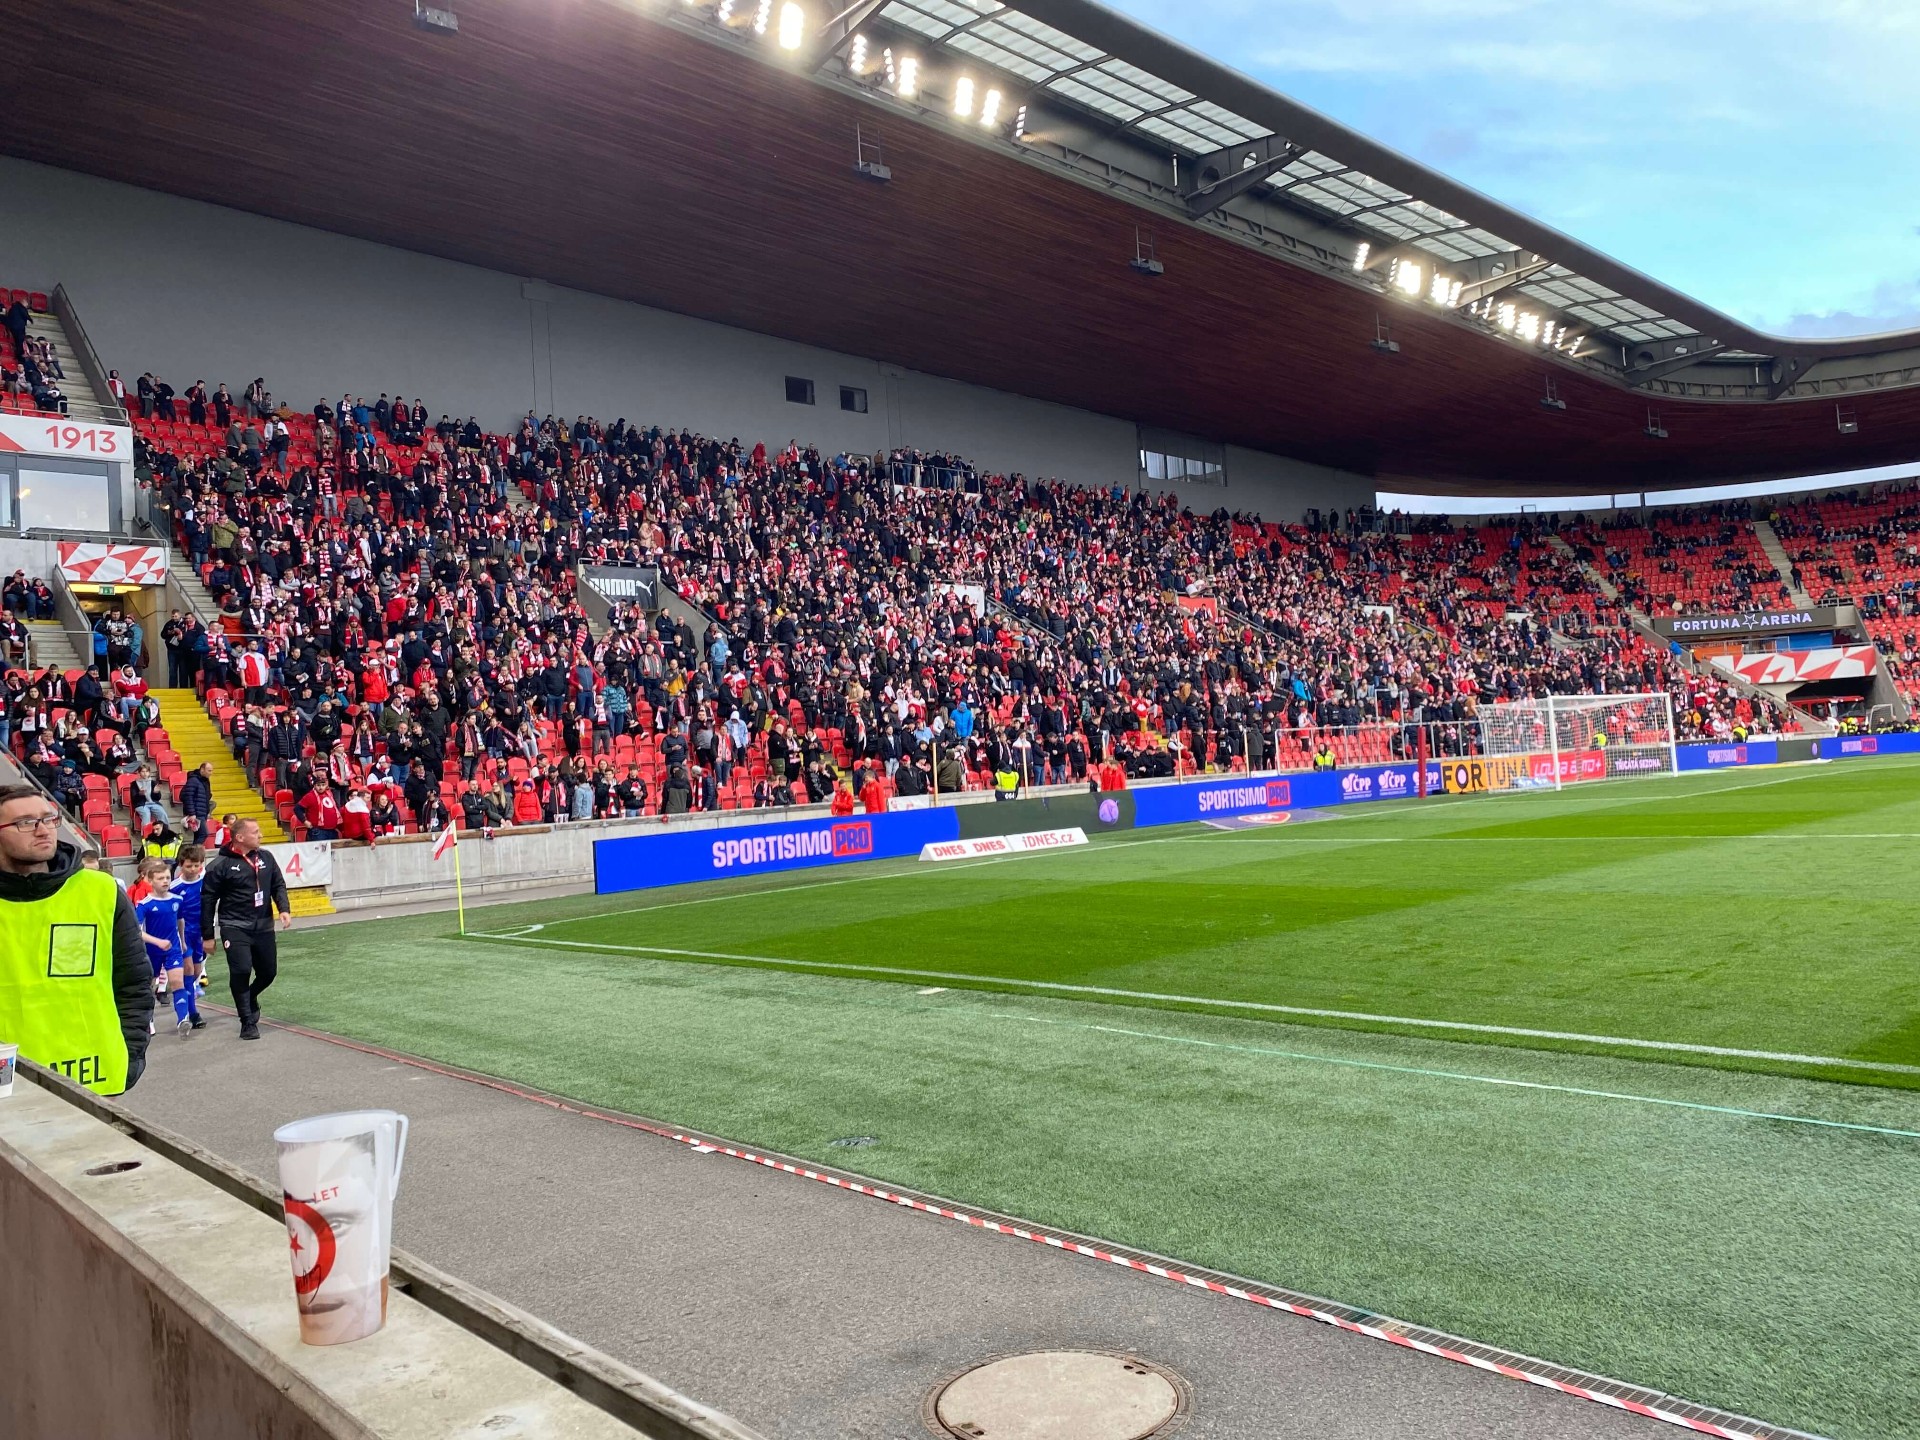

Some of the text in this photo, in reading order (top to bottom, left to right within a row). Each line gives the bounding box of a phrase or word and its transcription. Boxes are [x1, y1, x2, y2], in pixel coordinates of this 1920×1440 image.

[46, 425, 116, 453] 1913
[1673, 612, 1813, 632] FORTUNA ARENA
[1442, 759, 1530, 790] FORTUNA
[1199, 786, 1267, 811] SPORTISIMO
[712, 827, 869, 868] SPORTISIMO PRO
[933, 840, 1006, 857] DNES DNES
[1022, 832, 1075, 848] iDNES.cz
[285, 853, 303, 877] 4
[313, 1186, 339, 1204] LET
